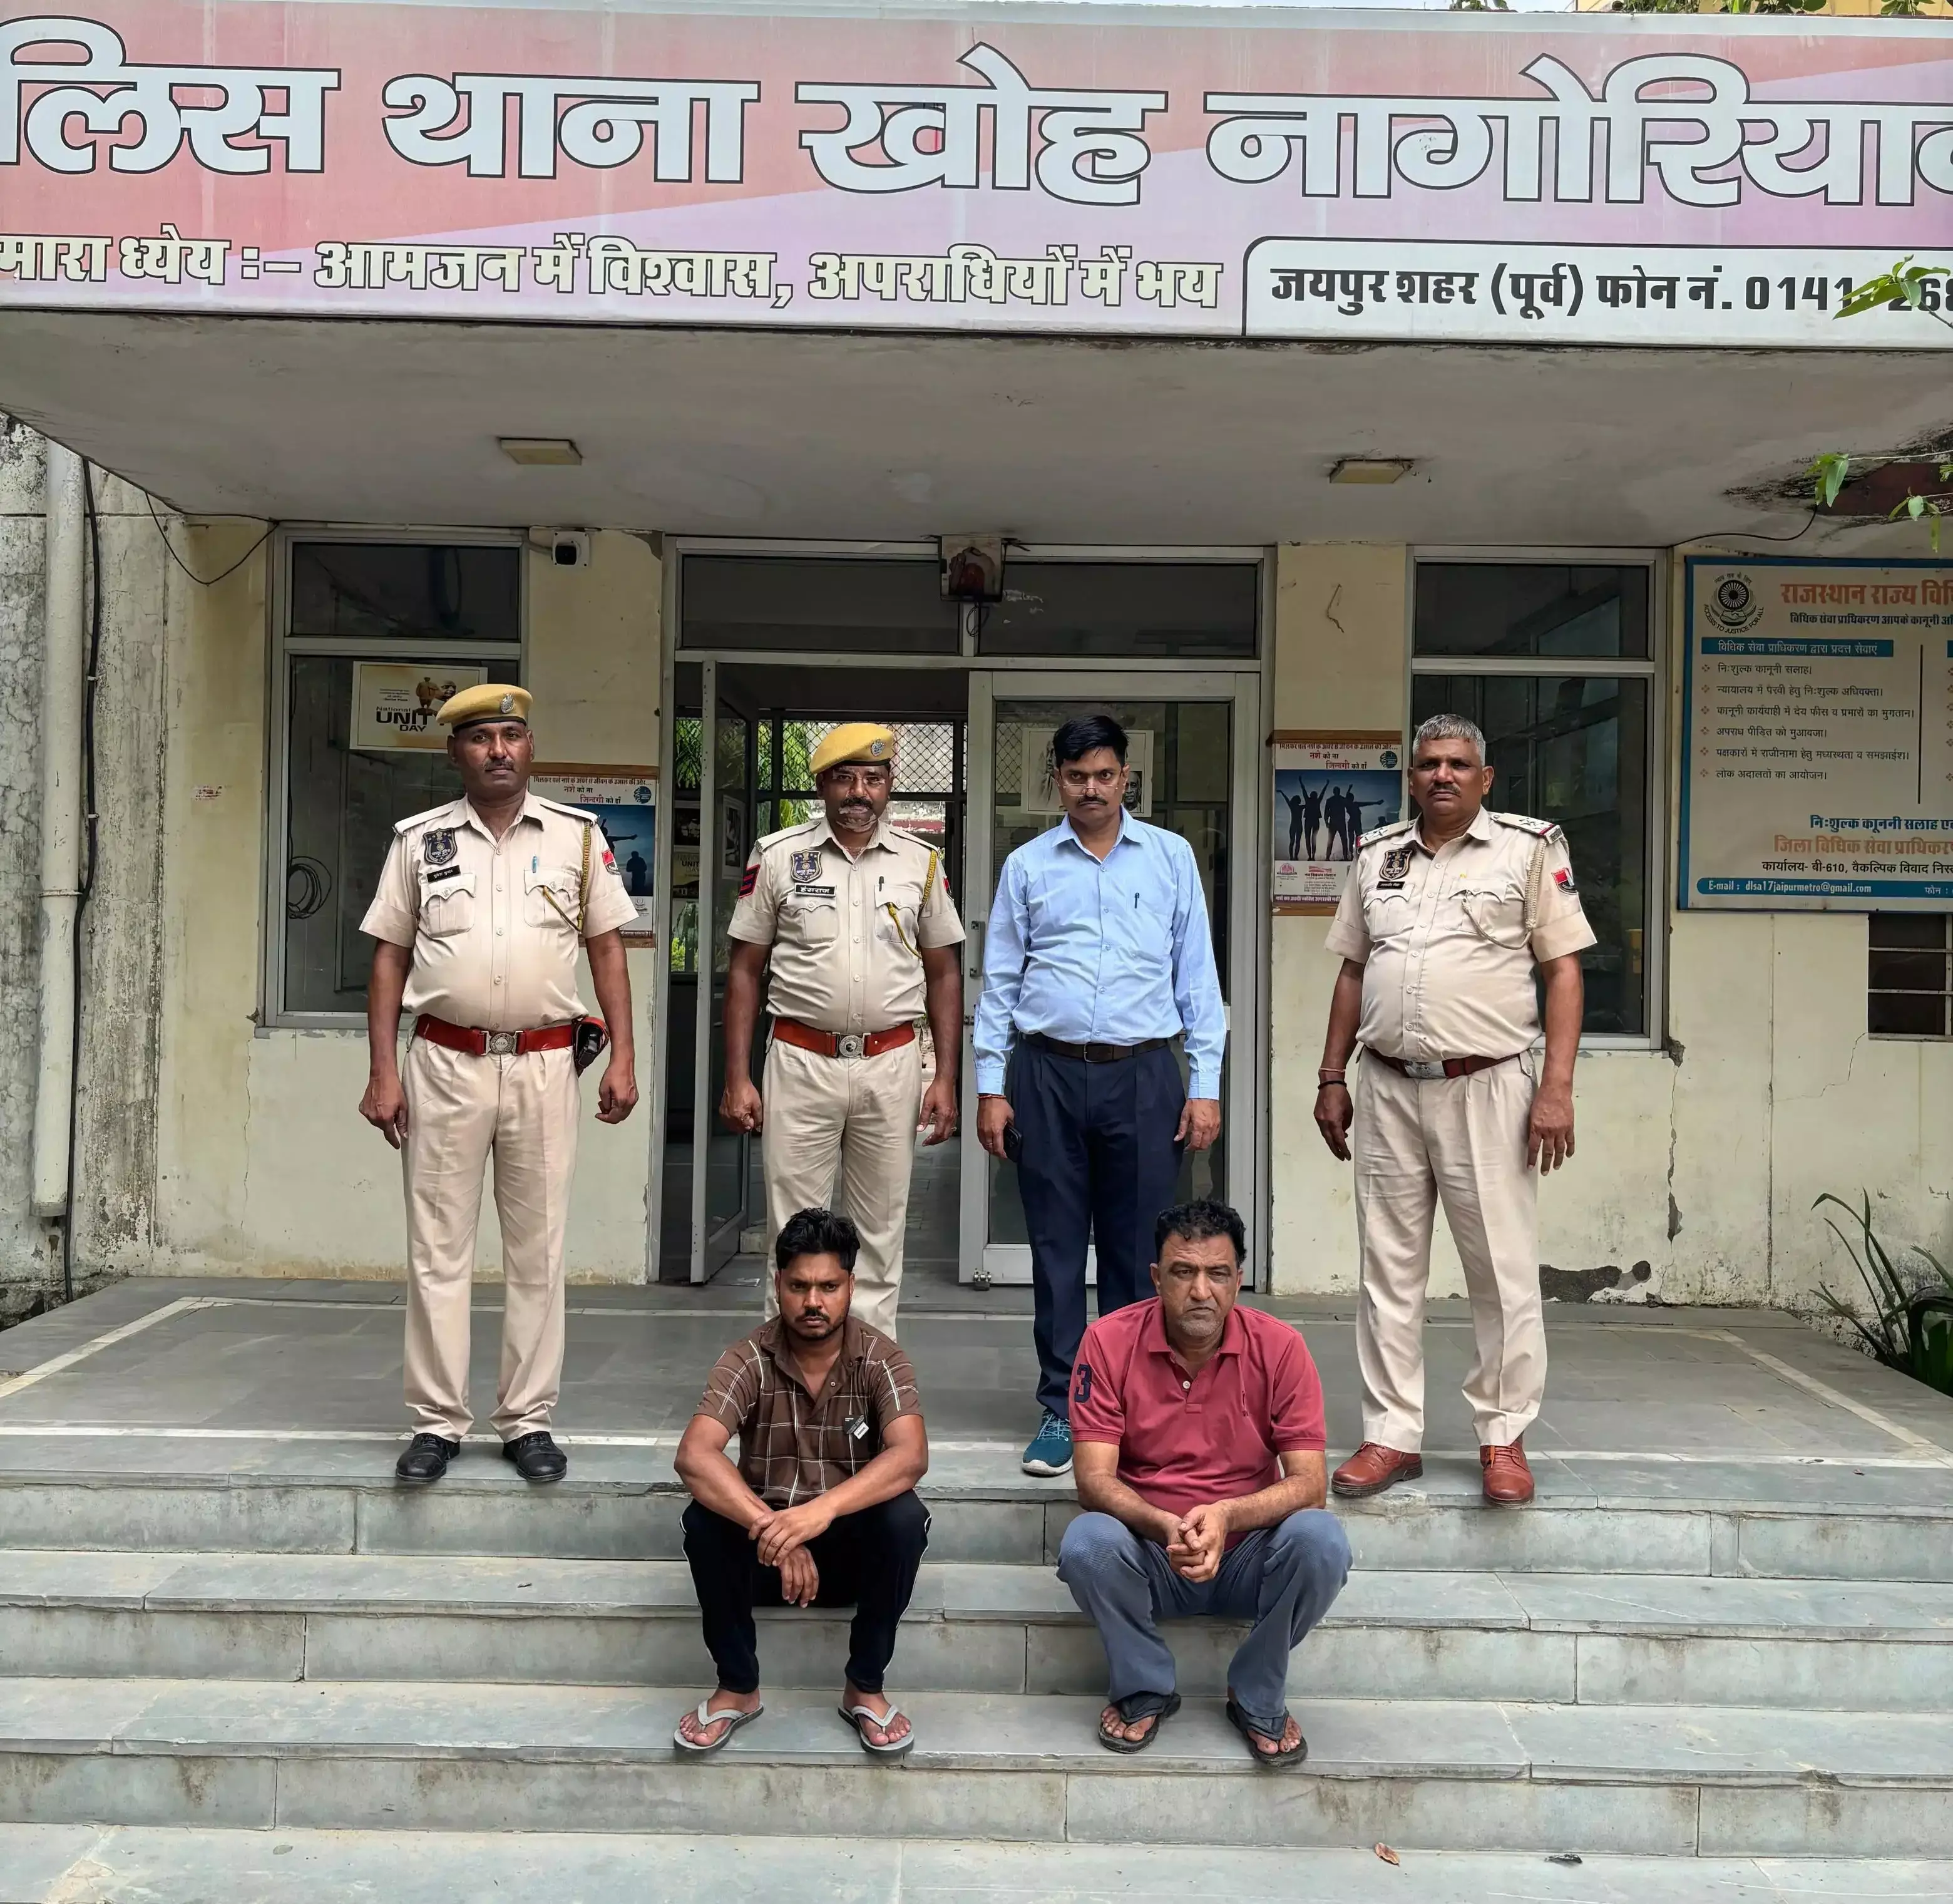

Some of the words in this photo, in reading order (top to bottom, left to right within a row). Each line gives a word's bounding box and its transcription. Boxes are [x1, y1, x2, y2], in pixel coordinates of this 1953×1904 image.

[381, 73, 761, 185] थाना
[794, 41, 1169, 206] खोह
[1203, 53, 1953, 208] नागोरिया
[119, 223, 232, 286] ध्येय
[314, 241, 526, 293] आमजन
[531, 232, 585, 294] में
[586, 235, 793, 309] विश्वास,
[807, 243, 1079, 306] अपराधियों
[1079, 245, 1133, 306] में
[1135, 260, 1224, 309] भय
[1269, 268, 1389, 316] जयपुर
[1395, 270, 1479, 306] शहर
[1490, 262, 1584, 321] (पूर्व)
[1596, 264, 1680, 310] फोन
[1686, 265, 1732, 311] नं.
[1780, 584, 1867, 604] राजस्थान
[1870, 585, 1917, 605] राज्य
[1703, 604, 1718, 626] ACCESS
[1725, 625, 1750, 634] JUSTICE
[1748, 617, 1760, 628] FOR
[1790, 612, 1817, 624] विधिक
[1820, 612, 1836, 624] सेवा
[1882, 614, 1908, 625] आपके
[1718, 640, 1745, 652] विधिक
[1748, 640, 1765, 652] सेवा
[1768, 641, 1807, 653] प्राधिकरण
[1810, 644, 1827, 654] द्वारा
[1755, 662, 1781, 676] कानूनी
[1716, 686, 1753, 694] न्यायालय
[1789, 684, 1801, 697] हेतु
[1716, 704, 1743, 718] कानूनी
[1746, 704, 1780, 716] कार्यवाही
[1810, 706, 1828, 717] फीस
[1867, 709, 1879, 718] का
[1716, 728, 1744, 736] अपराध
[1775, 726, 1786, 737] को
[1761, 747, 1798, 758] राजीनामा
[1800, 748, 1813, 761] हेतु
[1816, 751, 1853, 759] मध्यस्थता
[1715, 767, 1735, 778] लोक
[1738, 768, 1771, 779] अदालतों
[1775, 770, 1786, 779] का
[1904, 819, 1939, 830] सलाह
[1774, 834, 1813, 853] जिला
[1816, 835, 1862, 853] विधिक
[1863, 836, 1892, 855] सेवा
[1852, 860, 1897, 873] वैकल्पिक
[1899, 860, 1929, 874] विवाद
[1708, 880, 1734, 890] E-mail
[1745, 880, 1872, 894] dlsa17jaipurmetro@gmail.com
[1925, 885, 1941, 895] फोन
[1074, 1363, 1094, 1404] 3
